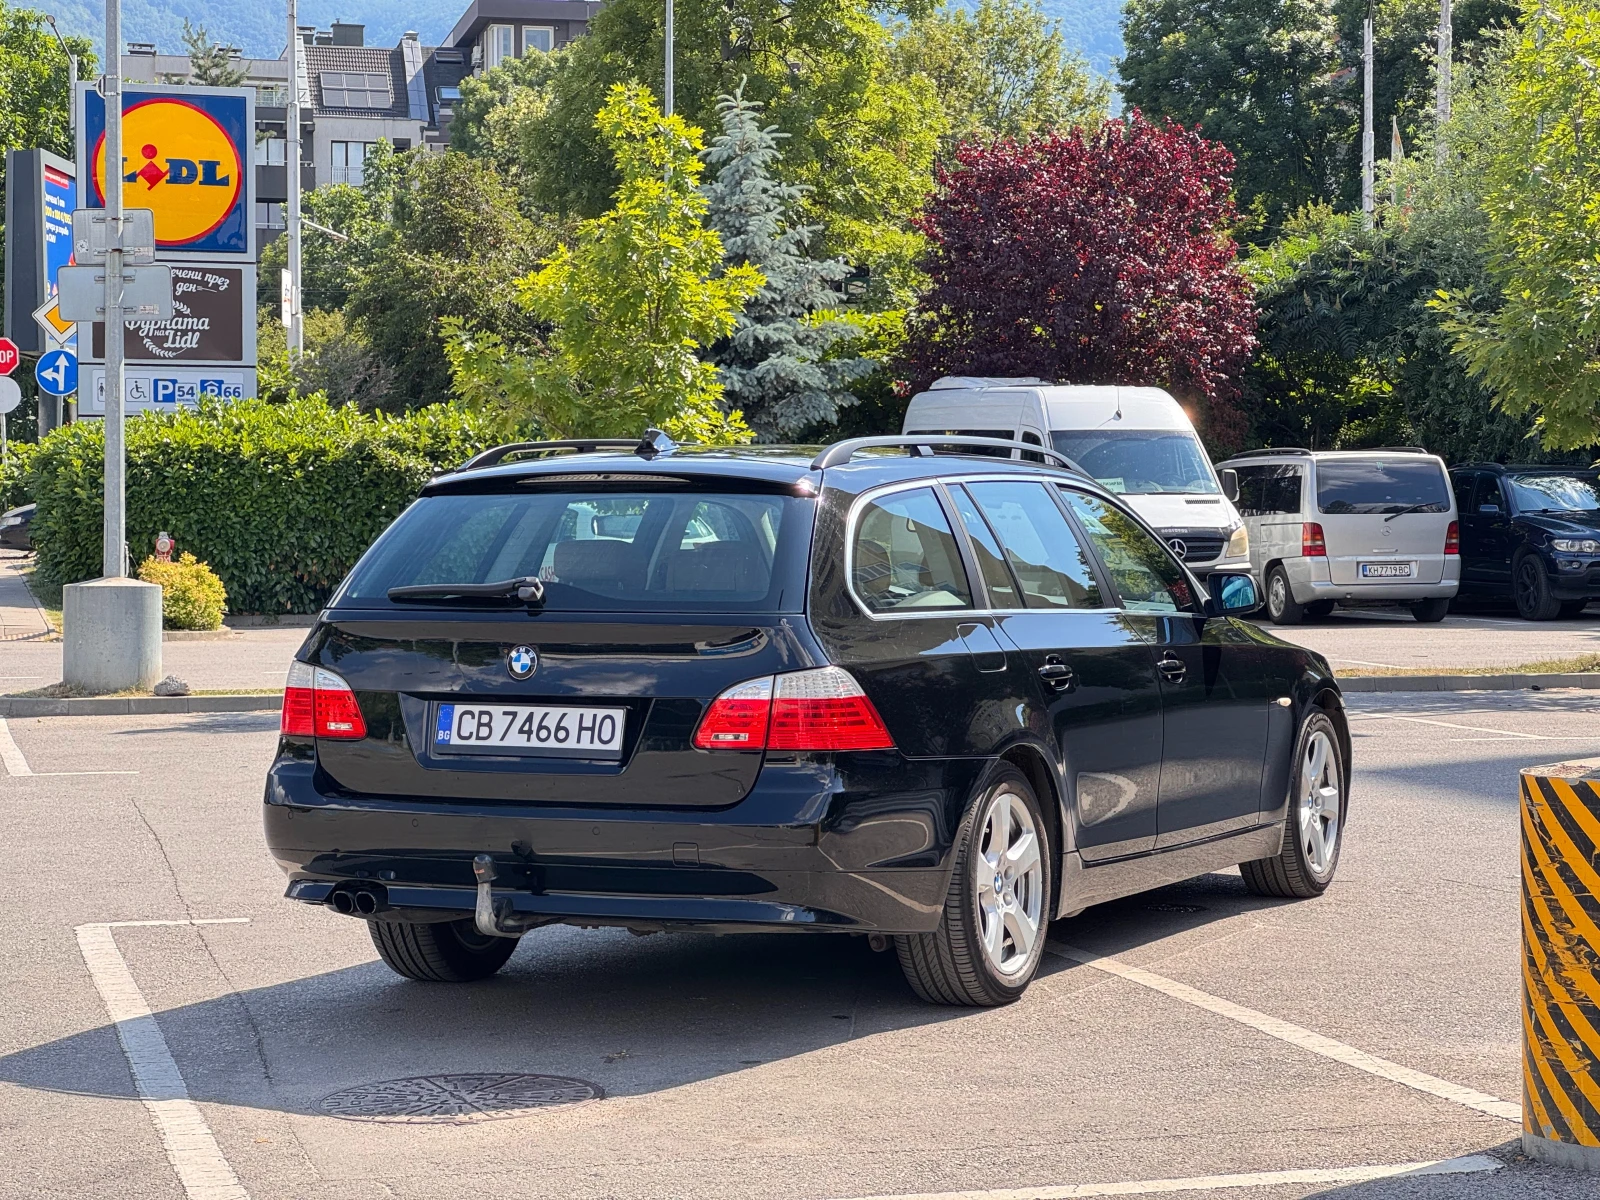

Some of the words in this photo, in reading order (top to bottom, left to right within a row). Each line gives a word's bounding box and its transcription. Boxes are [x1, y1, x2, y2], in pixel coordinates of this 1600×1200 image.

[171, 269, 202, 280] ечени
[204, 273, 230, 291] през
[175, 282, 197, 296] ден
[163, 330, 200, 348] Lidl
[0, 350, 14, 363] OP
[157, 380, 174, 401] P
[177, 386, 195, 397] 54
[223, 386, 241, 398] 66
[456, 709, 493, 741] CB
[498, 710, 570, 743] 7466
[438, 731, 450, 740] BG
